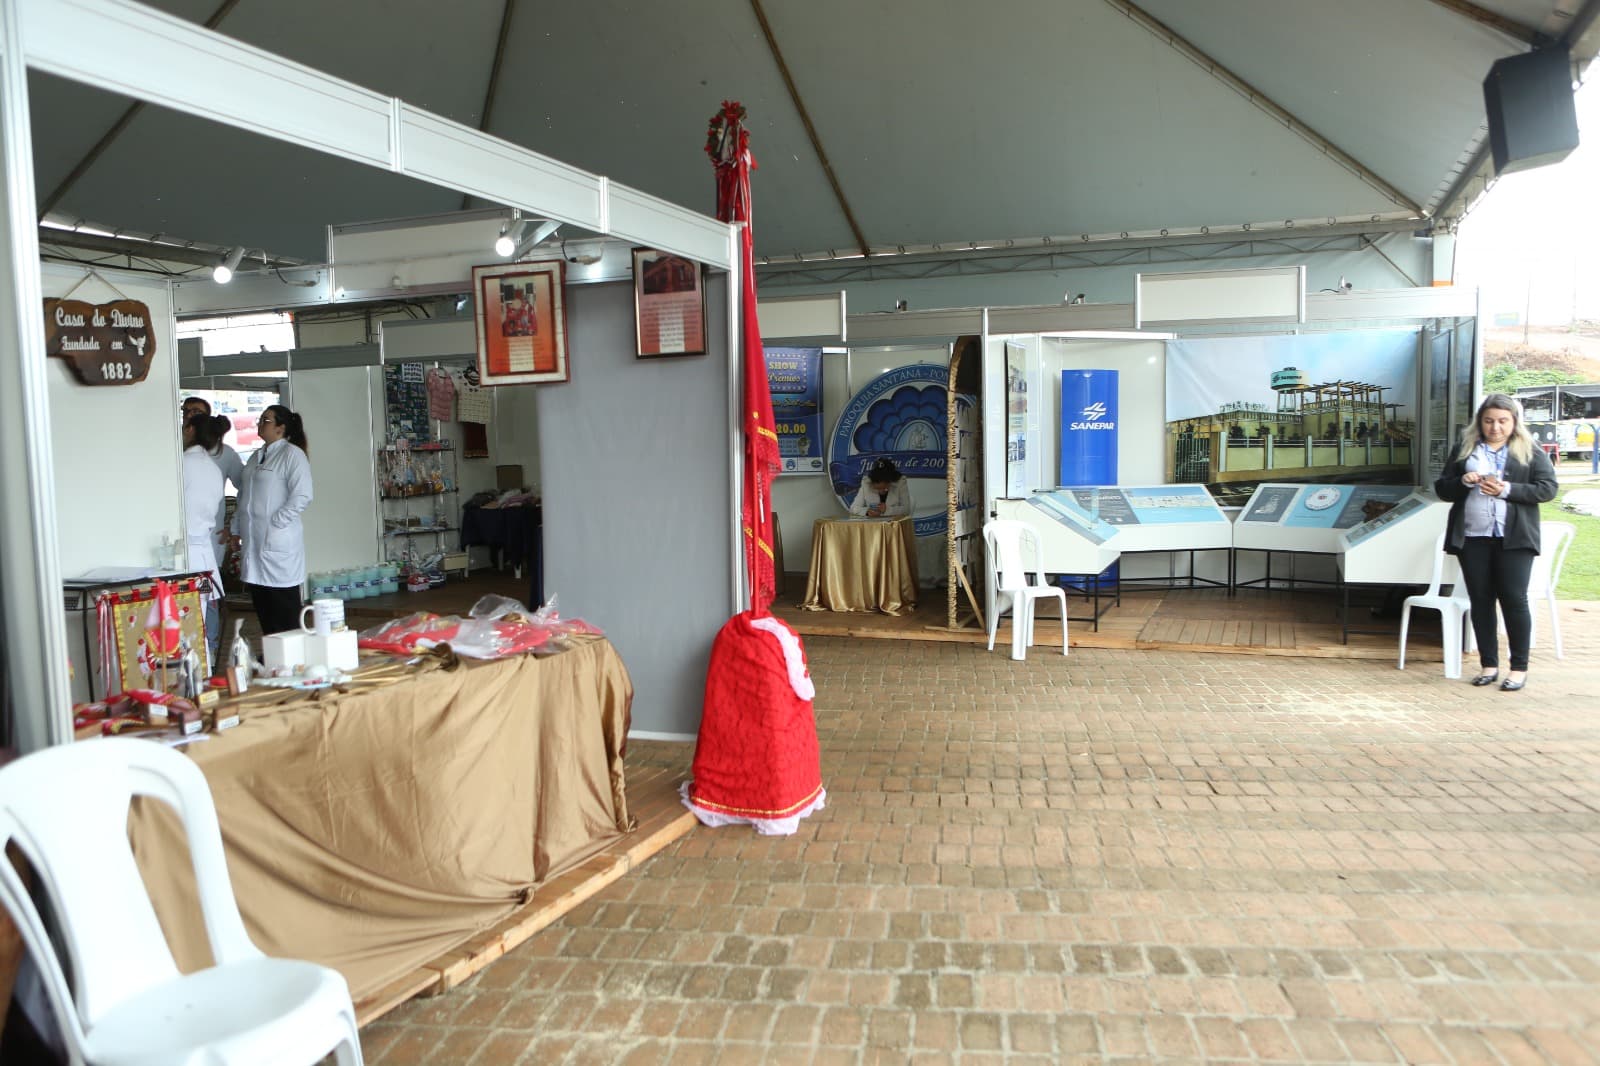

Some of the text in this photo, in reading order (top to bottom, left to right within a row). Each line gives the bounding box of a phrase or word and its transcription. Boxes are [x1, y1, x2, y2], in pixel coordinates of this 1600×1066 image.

[55, 306, 145, 328] Casa do Divino
[61, 335, 124, 351] Fundada em
[101, 362, 133, 380] 1882
[768, 361, 798, 370] SHOW
[1070, 422, 1115, 431] SANEPAR
[905, 457, 919, 468] de
[922, 458, 945, 468] 200
